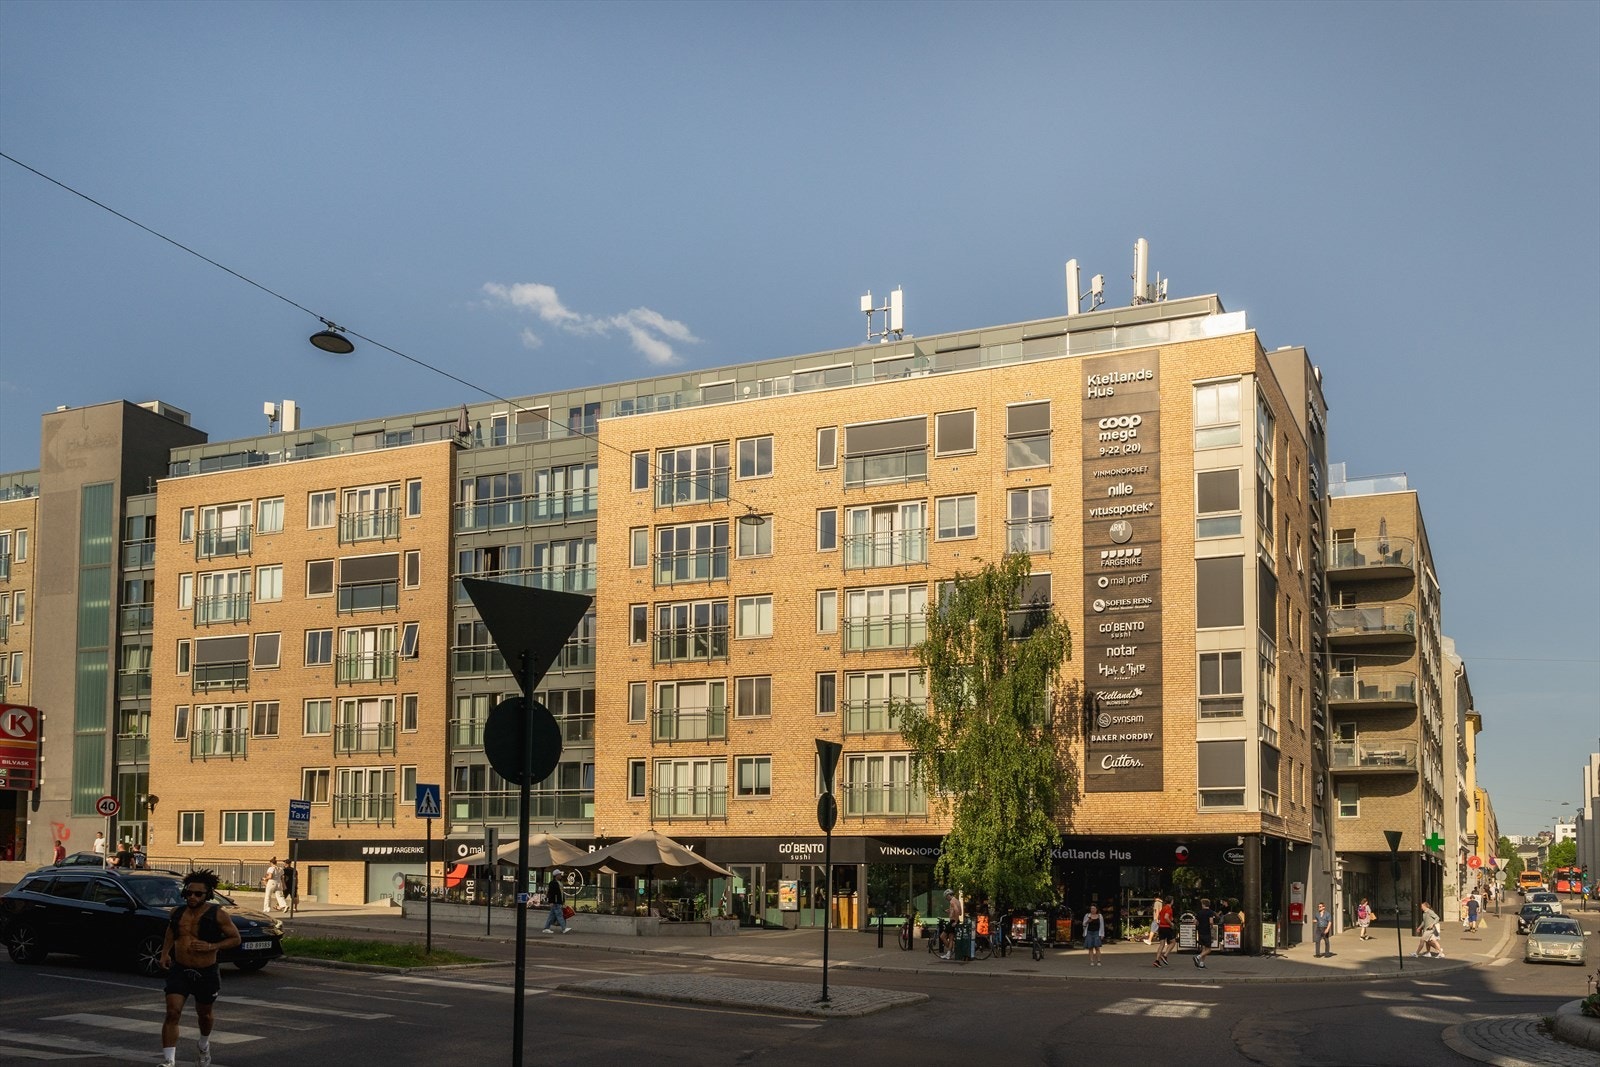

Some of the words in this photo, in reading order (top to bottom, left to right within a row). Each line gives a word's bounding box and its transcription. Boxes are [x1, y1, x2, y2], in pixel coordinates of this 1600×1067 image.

[1088, 369, 1153, 386] Kiellands
[1088, 387, 1114, 398] Hus
[1099, 414, 1142, 429] coop
[1099, 428, 1137, 442] mega
[1100, 446, 1120, 455] 9-22
[1123, 443, 1141, 454] (20)
[1093, 466, 1149, 477] VINMONOPOLET
[1108, 482, 1133, 496] nille
[1101, 557, 1142, 567] FARGERIKE
[1110, 576, 1126, 585] mal
[1127, 573, 1149, 585] proff
[1105, 599, 1131, 607] SOFIES
[1132, 597, 1152, 605] RENS
[1111, 631, 1131, 639] sushi
[1106, 644, 1137, 657] notar
[1091, 734, 1118, 742] BAKER
[1119, 732, 1154, 741] NORDBY
[101, 801, 116, 811] 40
[291, 810, 309, 819] Taxi
[393, 846, 425, 854] FARGERIKE
[880, 846, 943, 856] VINMONOPO
[1050, 849, 1106, 860] Kiellands
[1109, 849, 1132, 860] Hus
